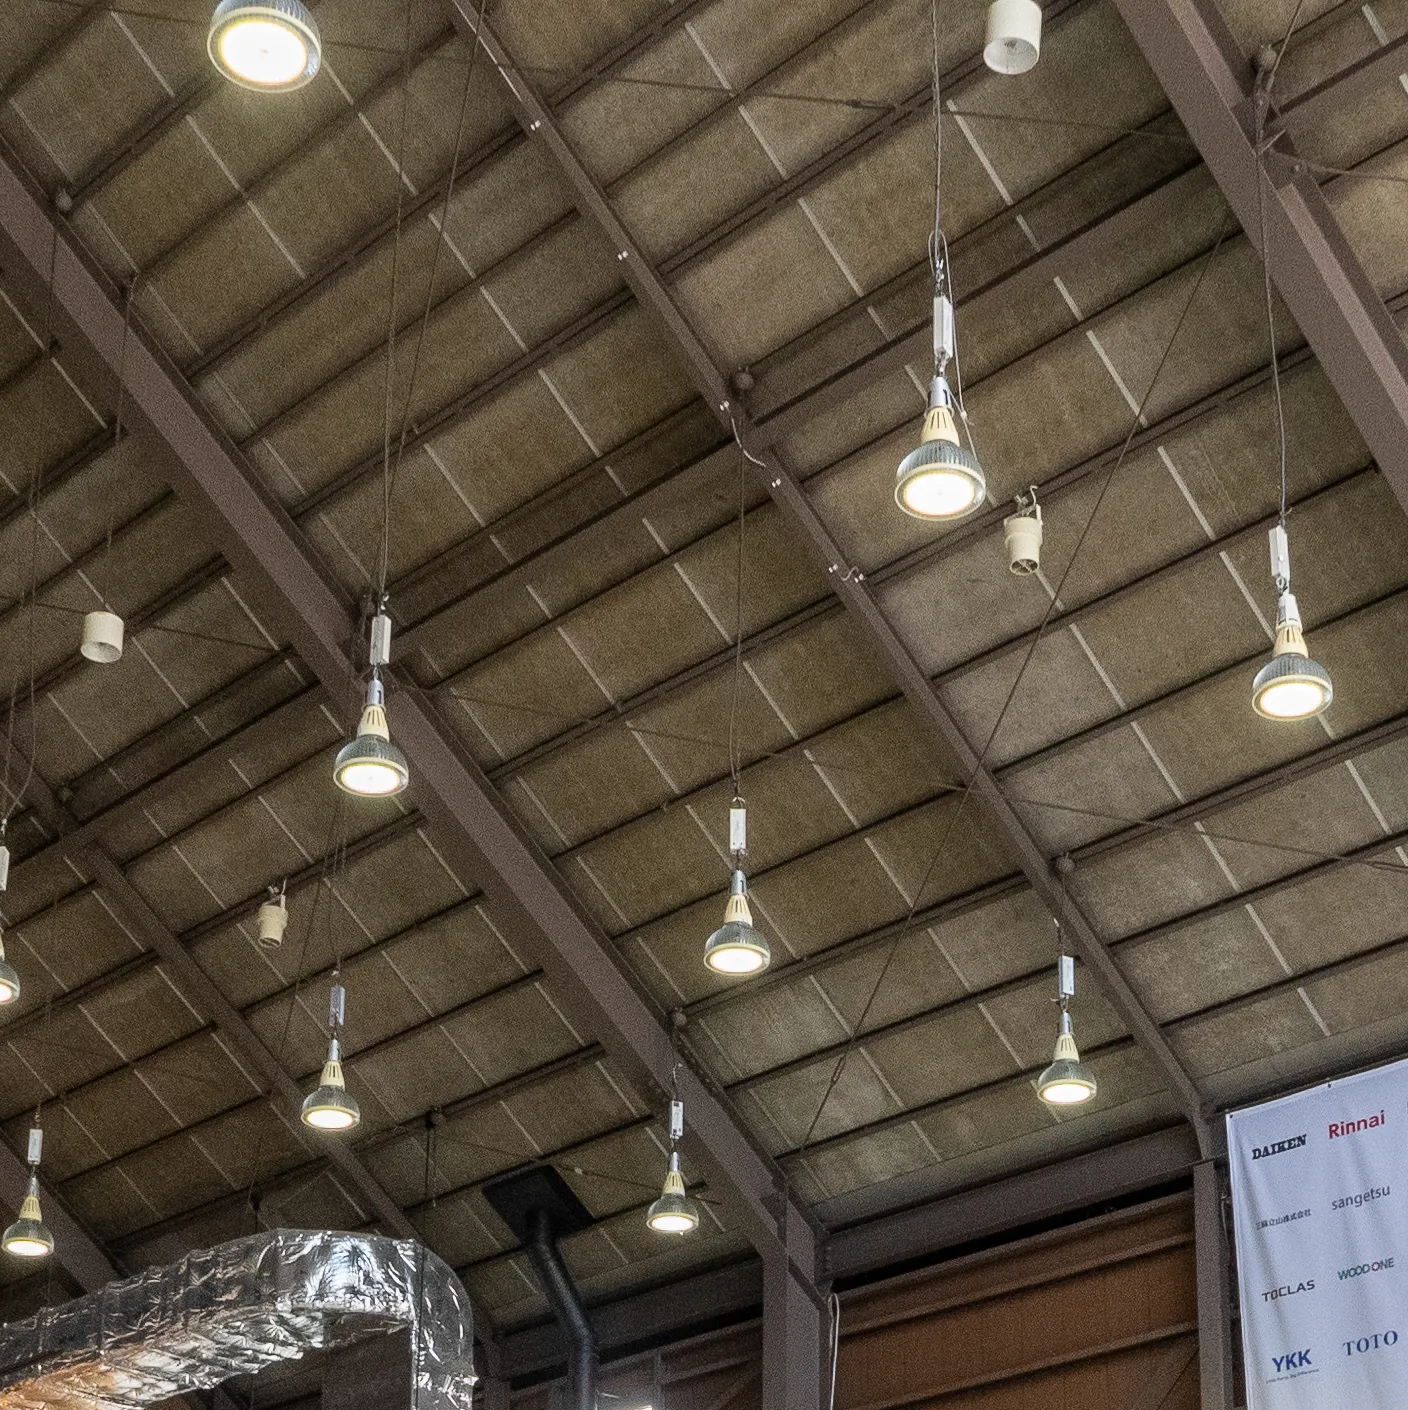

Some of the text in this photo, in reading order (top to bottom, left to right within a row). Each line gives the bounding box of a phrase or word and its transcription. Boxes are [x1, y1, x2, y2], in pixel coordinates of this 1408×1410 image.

[1328, 1110, 1385, 1139] Rinnai
[1252, 1134, 1307, 1160] DAIKEN
[1331, 1186, 1391, 1211] sangetsu
[1261, 1280, 1316, 1302] TOCLAS
[1343, 1330, 1398, 1356] TOTO
[1272, 1348, 1312, 1372] YKK
